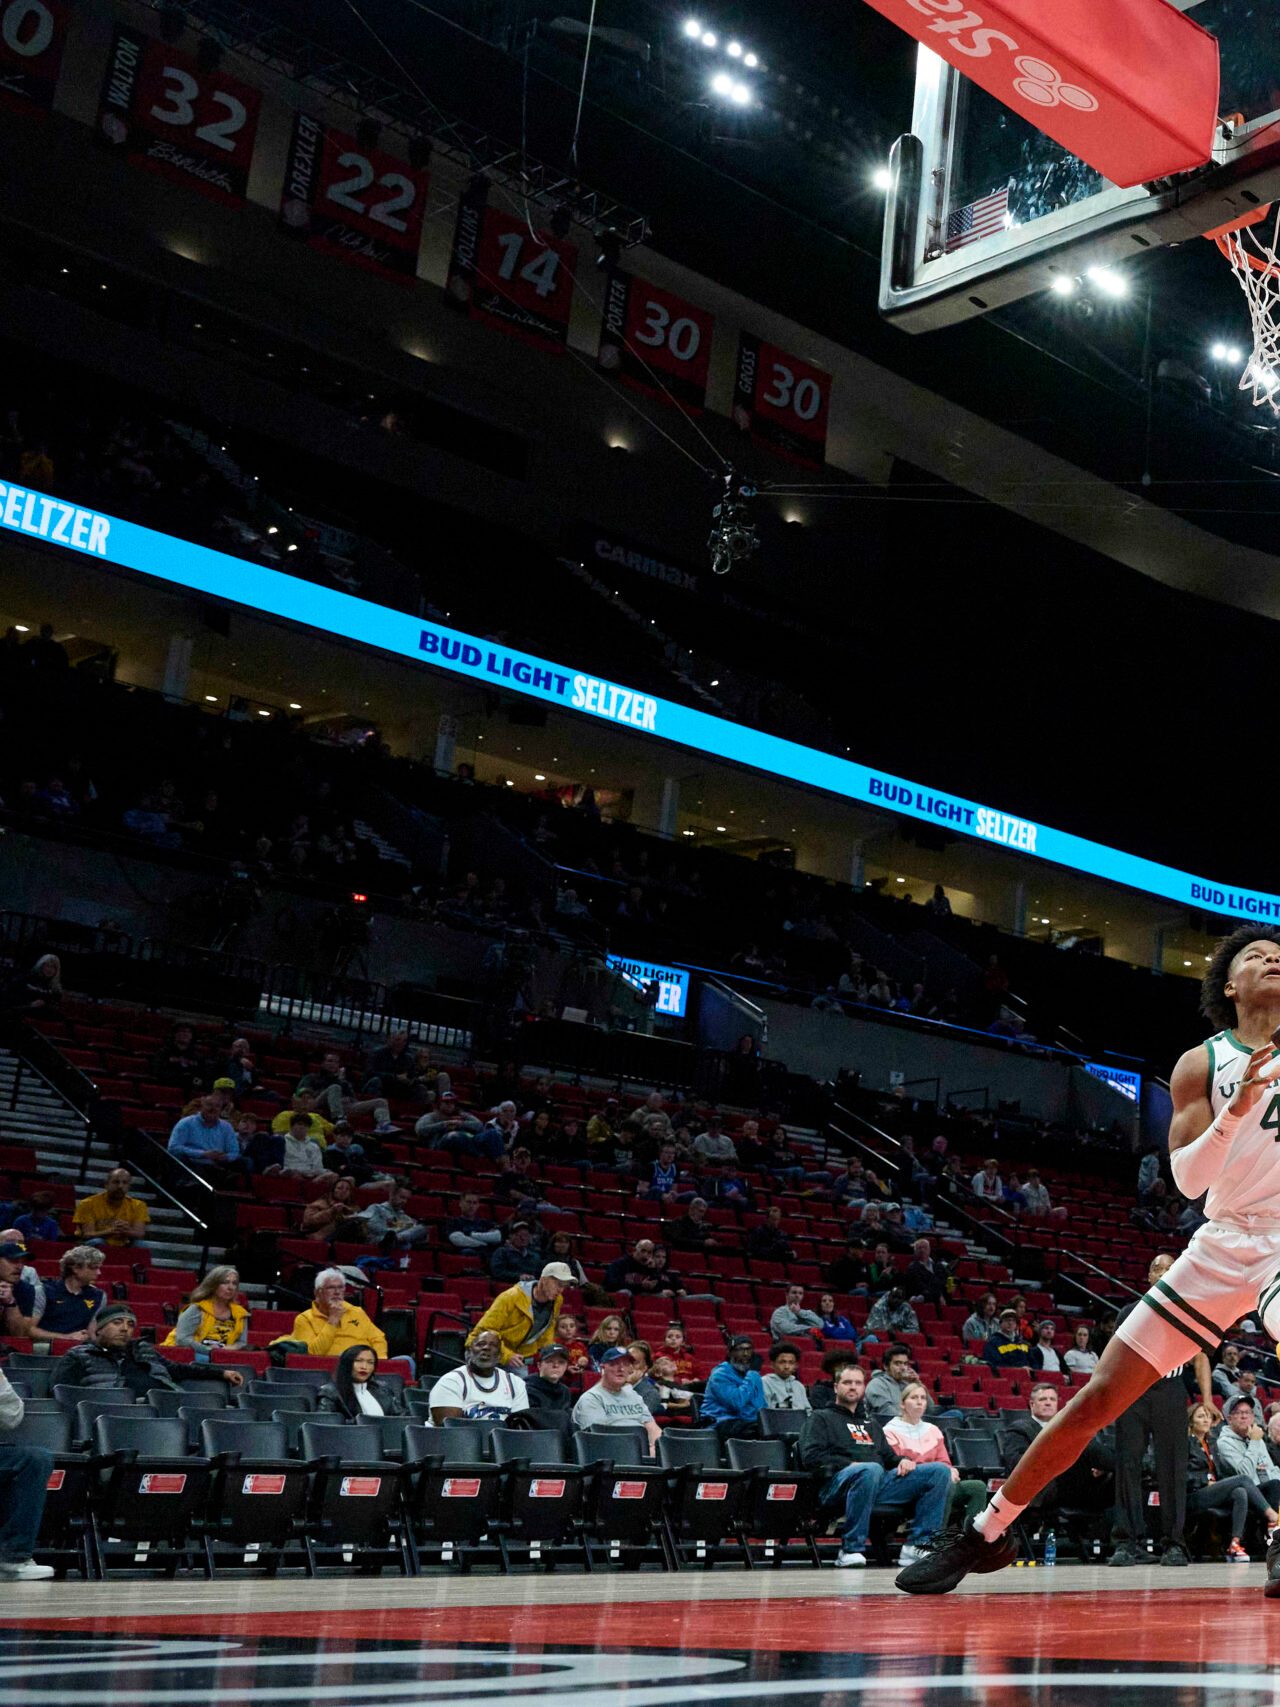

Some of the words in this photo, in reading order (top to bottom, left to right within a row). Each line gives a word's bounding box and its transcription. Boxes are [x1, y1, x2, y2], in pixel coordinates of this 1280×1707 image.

[105, 36, 141, 109] WALTON
[150, 66, 248, 153] 32
[291, 114, 322, 203] DREXLER
[324, 151, 417, 233] 22
[454, 205, 480, 267] HOLLINS
[497, 232, 561, 298] 14
[605, 279, 627, 334] PORTER
[634, 300, 702, 362] 30
[738, 346, 758, 394] GROSS
[763, 362, 822, 421] 30
[418, 629, 483, 667] BUD
[485, 652, 571, 697] LIGHT
[571, 674, 658, 731] SELTZER
[868, 776, 913, 807] BUD
[916, 792, 975, 826] LIGHT
[975, 807, 1038, 852] SELTZER
[1190, 883, 1225, 906] BUD
[643, 967, 684, 984] LIGHT
